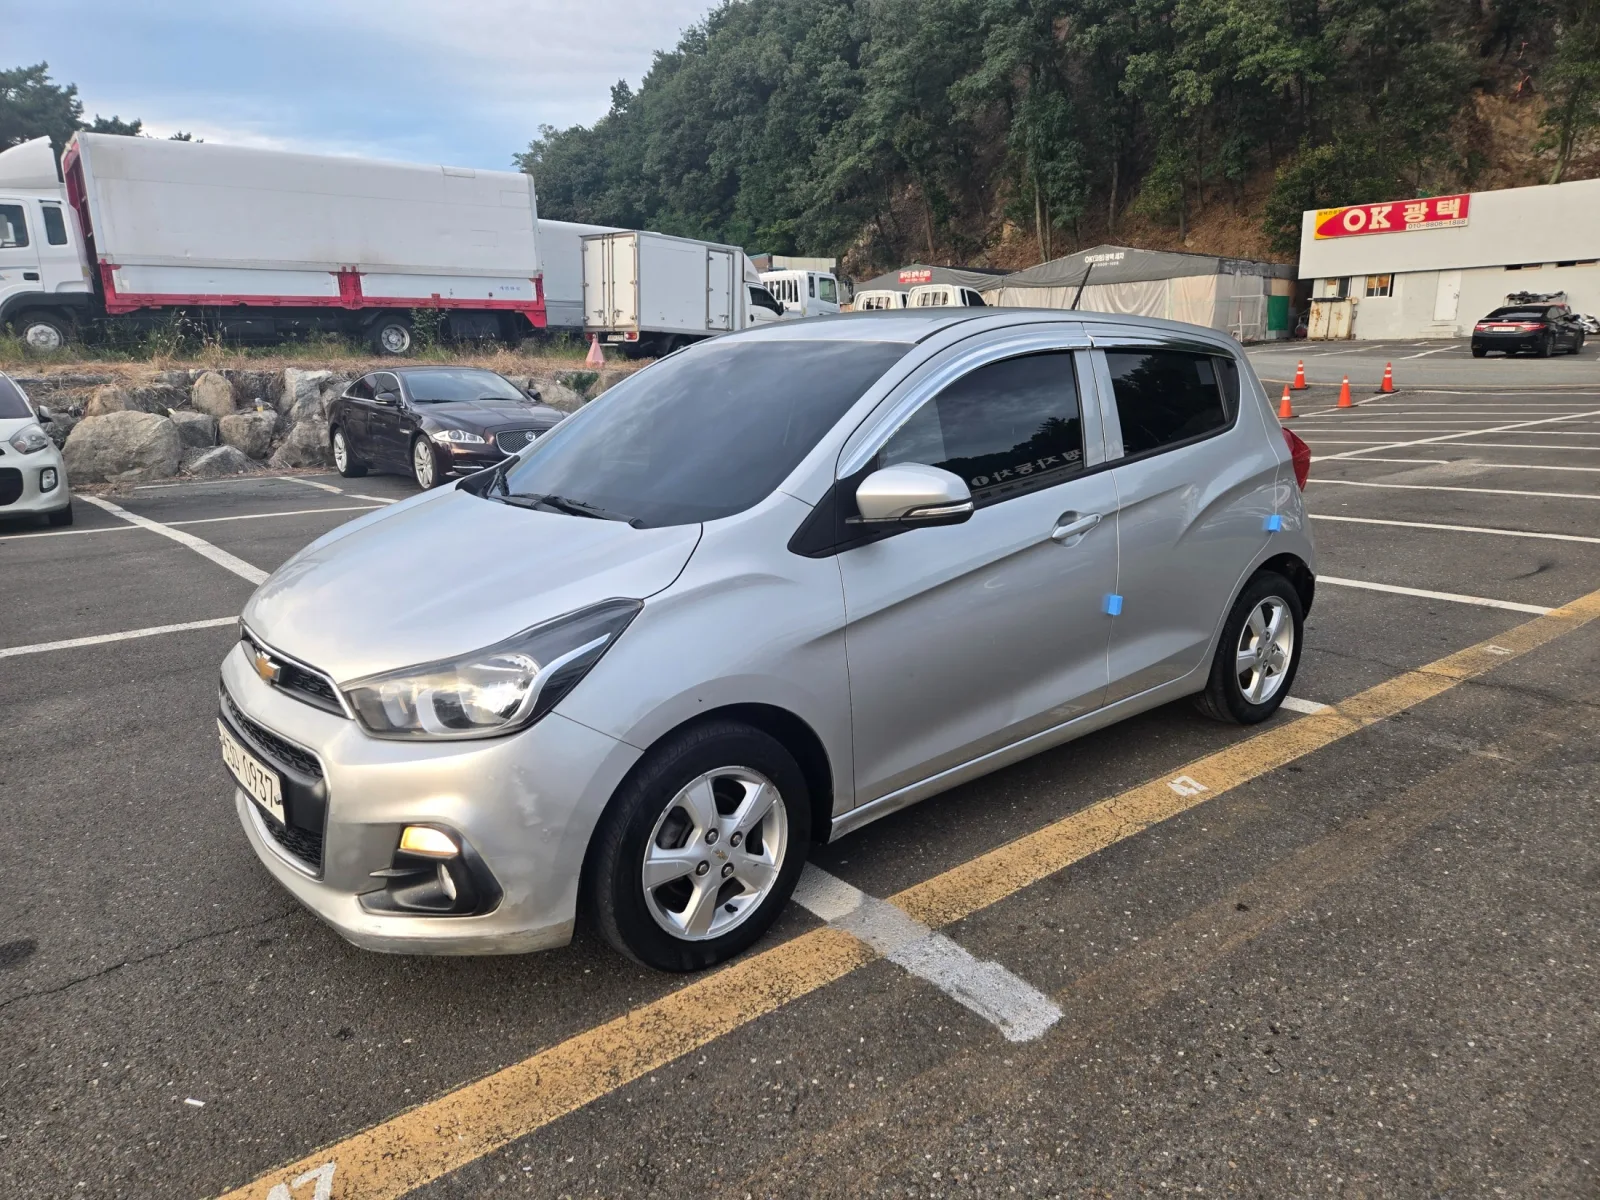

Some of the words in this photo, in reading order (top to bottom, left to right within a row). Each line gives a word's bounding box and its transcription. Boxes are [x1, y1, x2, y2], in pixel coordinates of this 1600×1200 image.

[1343, 205, 1392, 231] OK
[1402, 198, 1461, 223] 광택
[1408, 219, 1466, 230] 010-8808-1888
[242, 755, 273, 808] 0937
